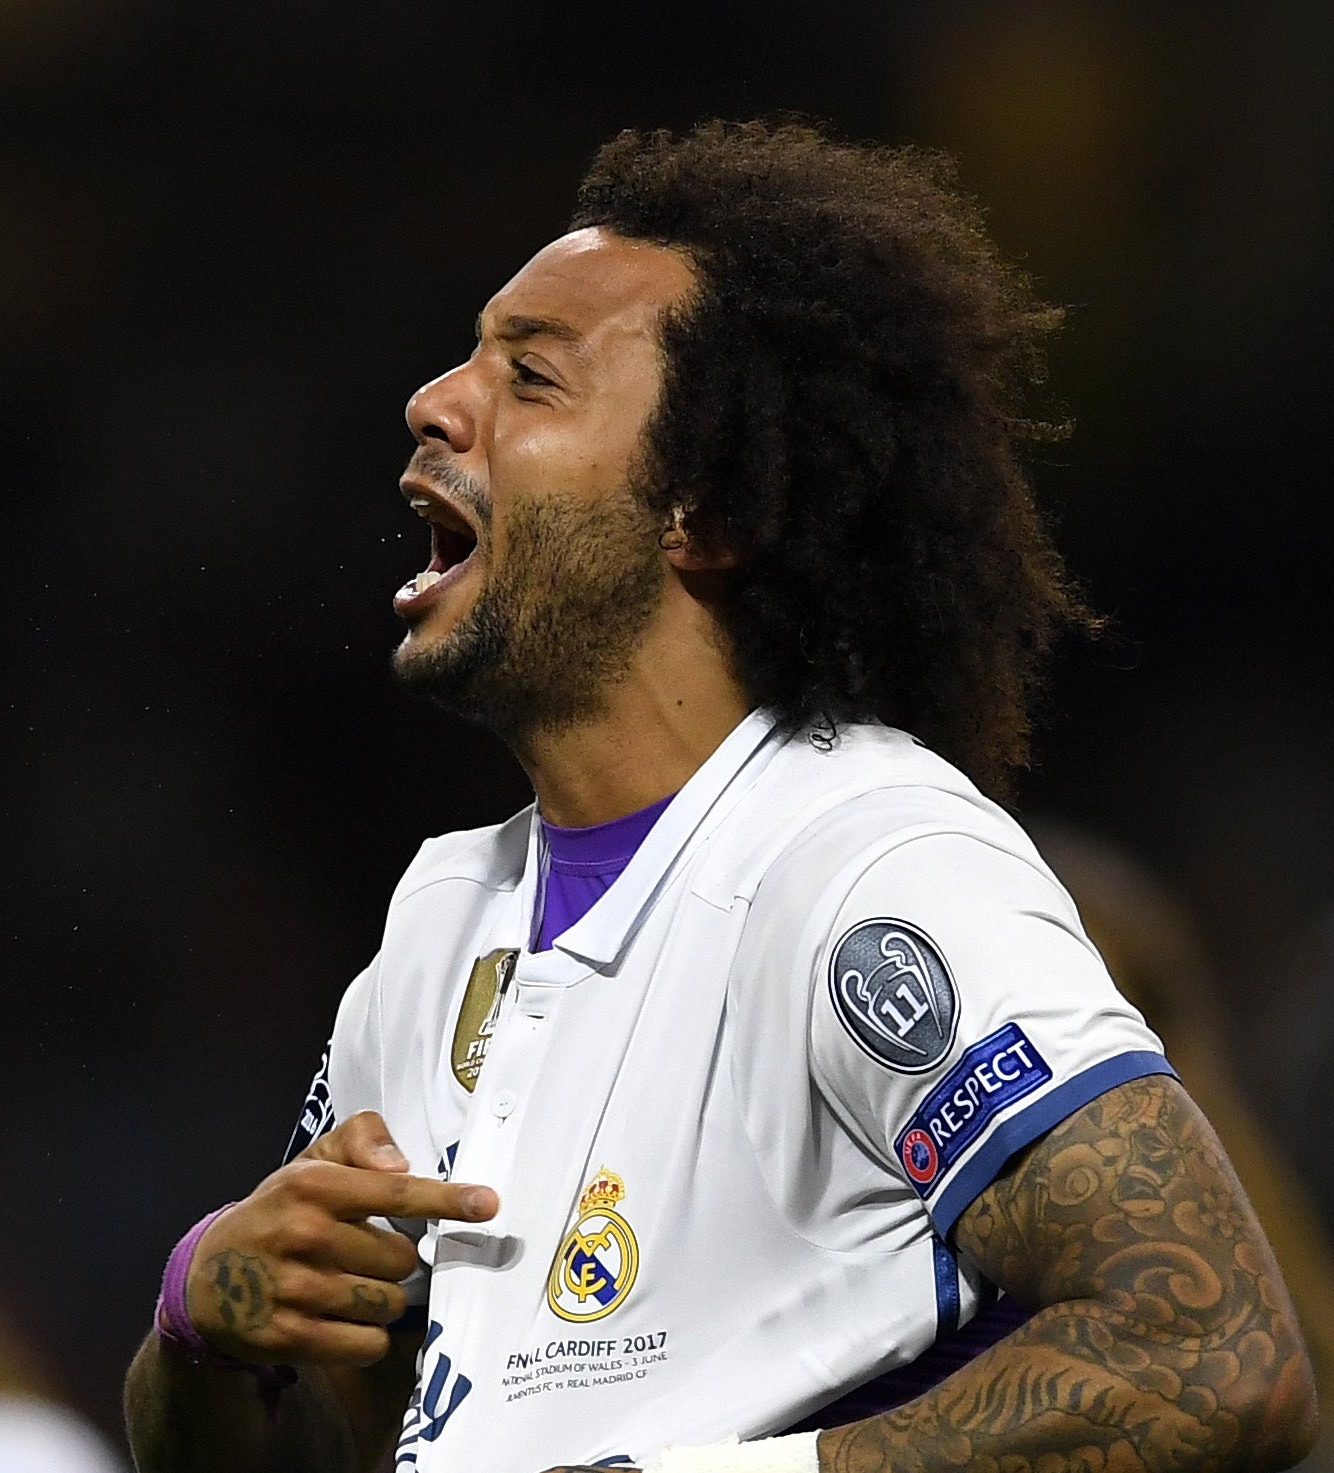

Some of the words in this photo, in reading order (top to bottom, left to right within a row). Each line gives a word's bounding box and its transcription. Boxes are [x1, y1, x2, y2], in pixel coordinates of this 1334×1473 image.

[880, 983, 929, 1038] 11
[467, 1039, 487, 1060] FI
[928, 1039, 1035, 1147] RESPECT
[545, 1340, 617, 1359] CARDIFF
[623, 1331, 667, 1354] 2017
[573, 1362, 587, 1373] OF
[588, 1359, 623, 1372] WALES
[631, 1357, 639, 1367] 3
[641, 1351, 668, 1365] JUNE
[567, 1379, 591, 1388] REAL
[592, 1372, 634, 1386] MADRID
[635, 1369, 647, 1379] CF
